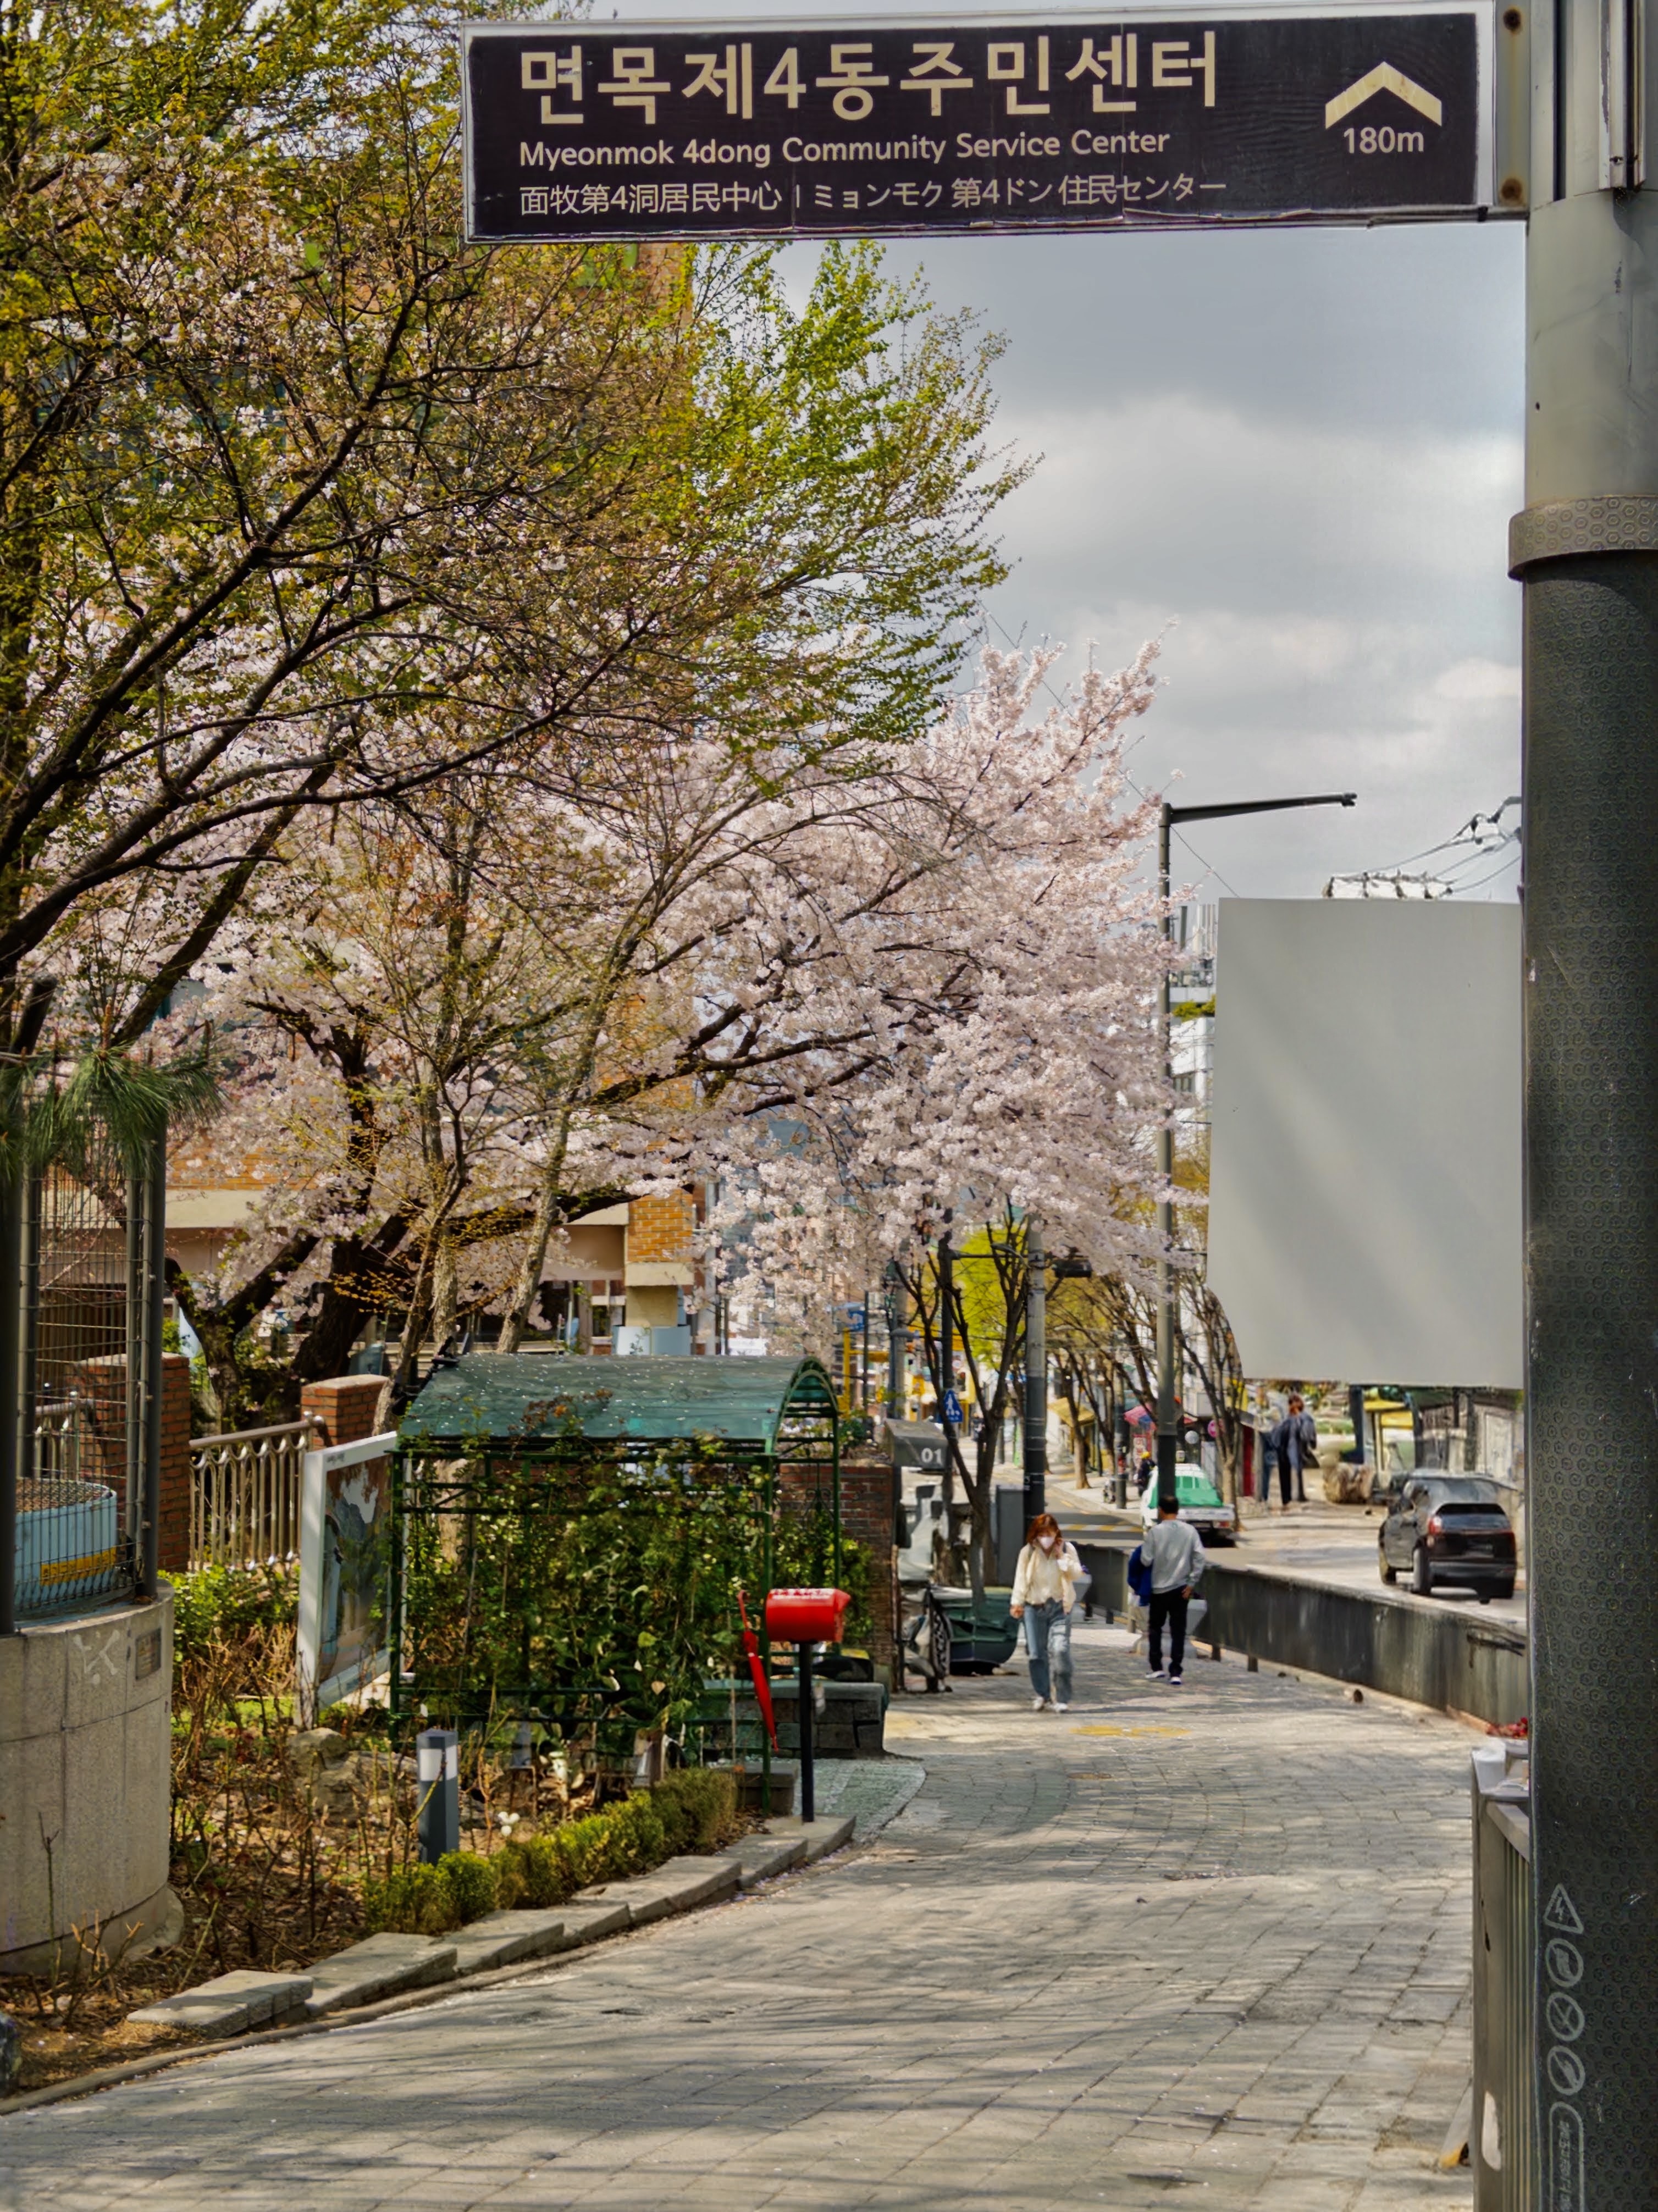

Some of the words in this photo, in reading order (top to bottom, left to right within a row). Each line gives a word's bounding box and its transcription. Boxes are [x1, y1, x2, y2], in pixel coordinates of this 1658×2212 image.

[521, 31, 1215, 124] 면목제4동주민센터
[519, 139, 675, 171] Myeonmok
[682, 139, 771, 168] 4dong
[782, 134, 947, 164] Community
[956, 131, 1060, 158] Service
[1071, 129, 1171, 155] Center
[1344, 126, 1424, 154] 180m
[519, 180, 783, 215] 面牧第4洞居民中心
[921, 1447, 942, 1464] 01
